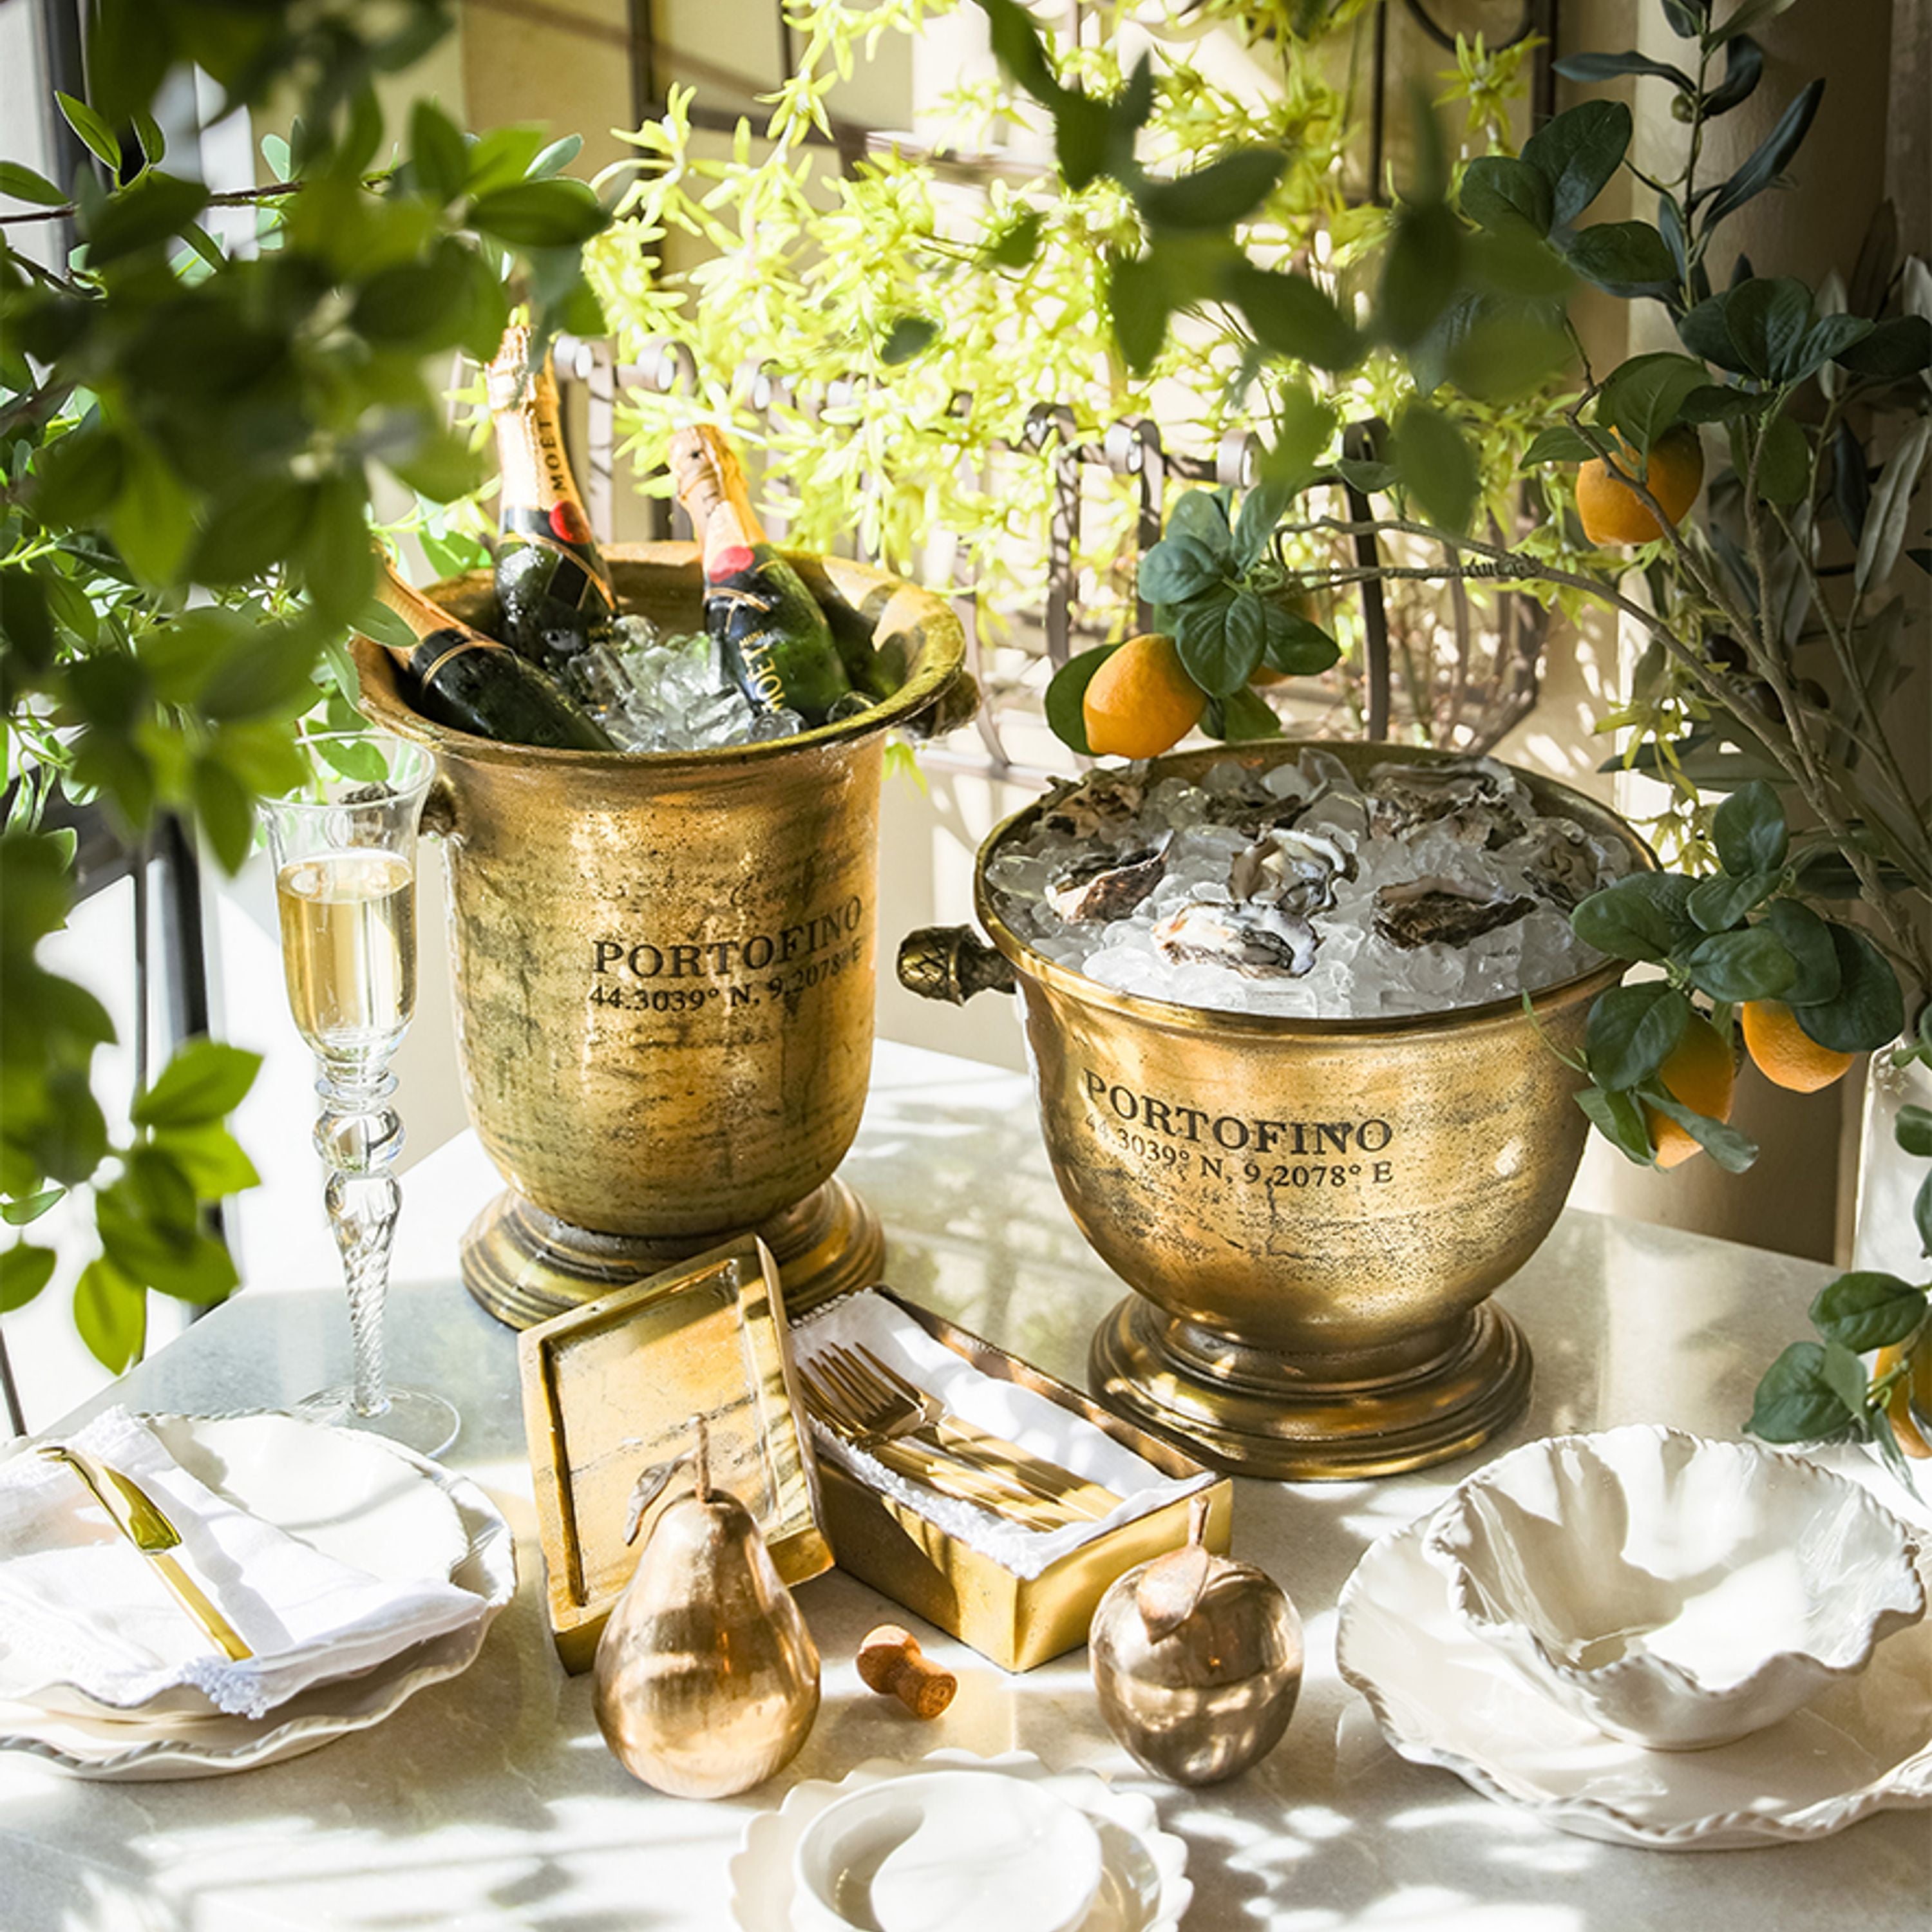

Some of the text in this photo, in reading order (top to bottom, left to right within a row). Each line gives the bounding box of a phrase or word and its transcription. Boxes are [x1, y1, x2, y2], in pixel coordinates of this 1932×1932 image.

[589, 985, 719, 1012] 44.3039°
[852, 937, 862, 962] E
[592, 895, 862, 978] PORTOFINO
[1084, 1068, 1393, 1155] PORTOFINO
[1373, 1161, 1393, 1184] E
